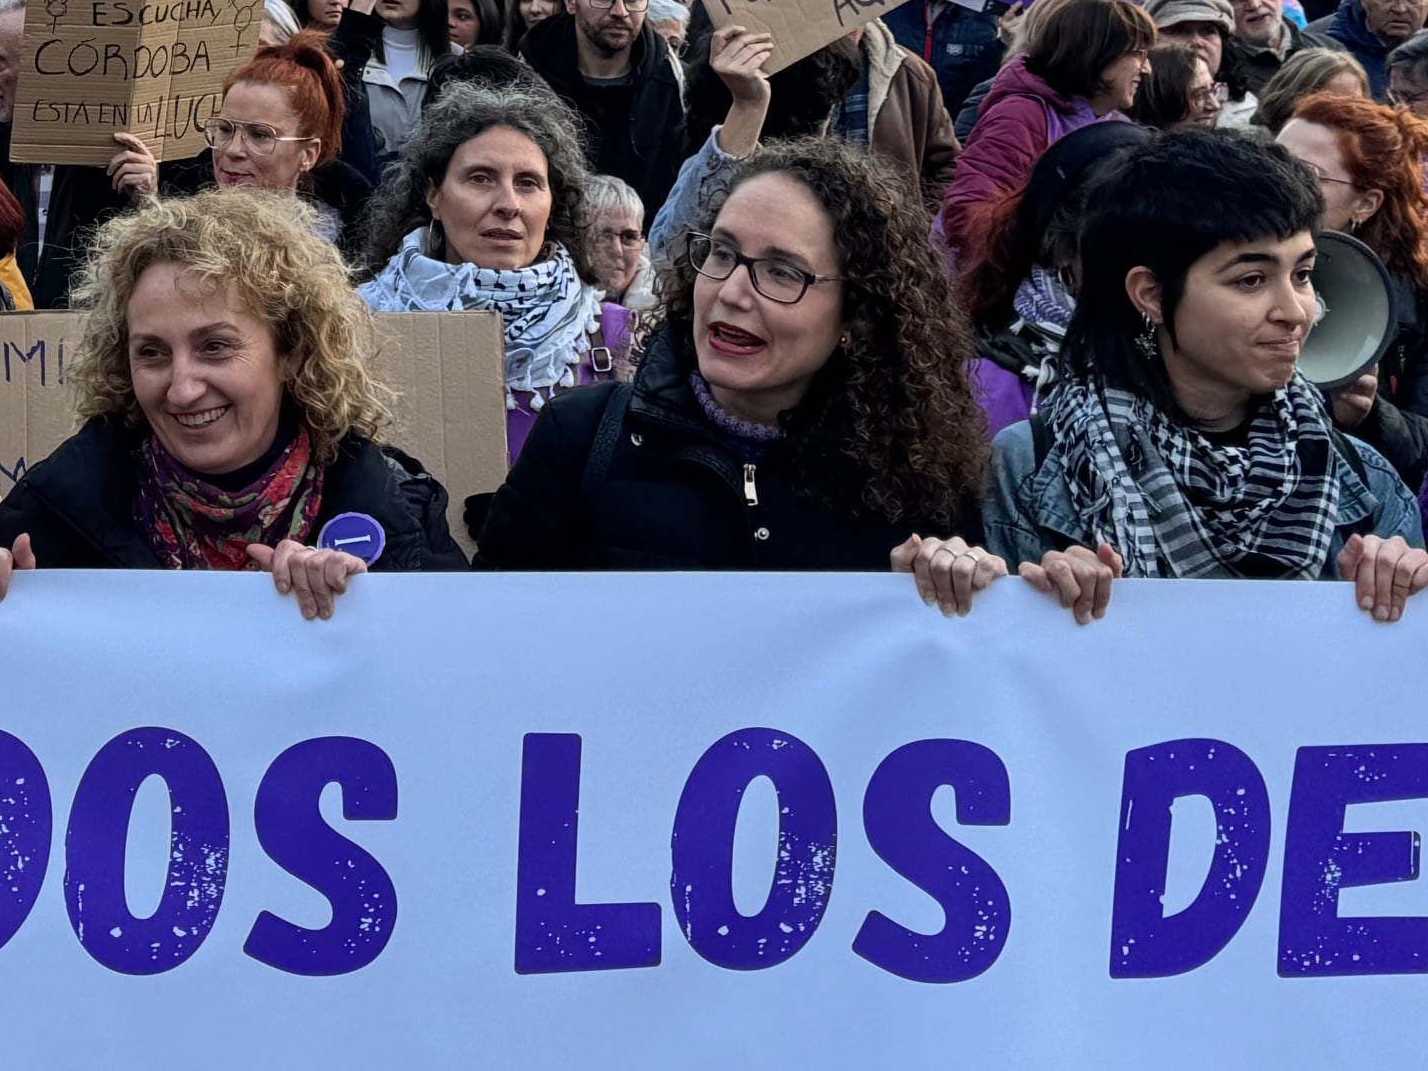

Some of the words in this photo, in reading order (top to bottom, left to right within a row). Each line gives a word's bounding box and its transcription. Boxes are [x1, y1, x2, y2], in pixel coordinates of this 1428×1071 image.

[34, 37, 210, 81] CÓRDOBA
[32, 98, 90, 125] ESTA
[98, 102, 128, 126] EN
[514, 727, 1013, 984] LOS
